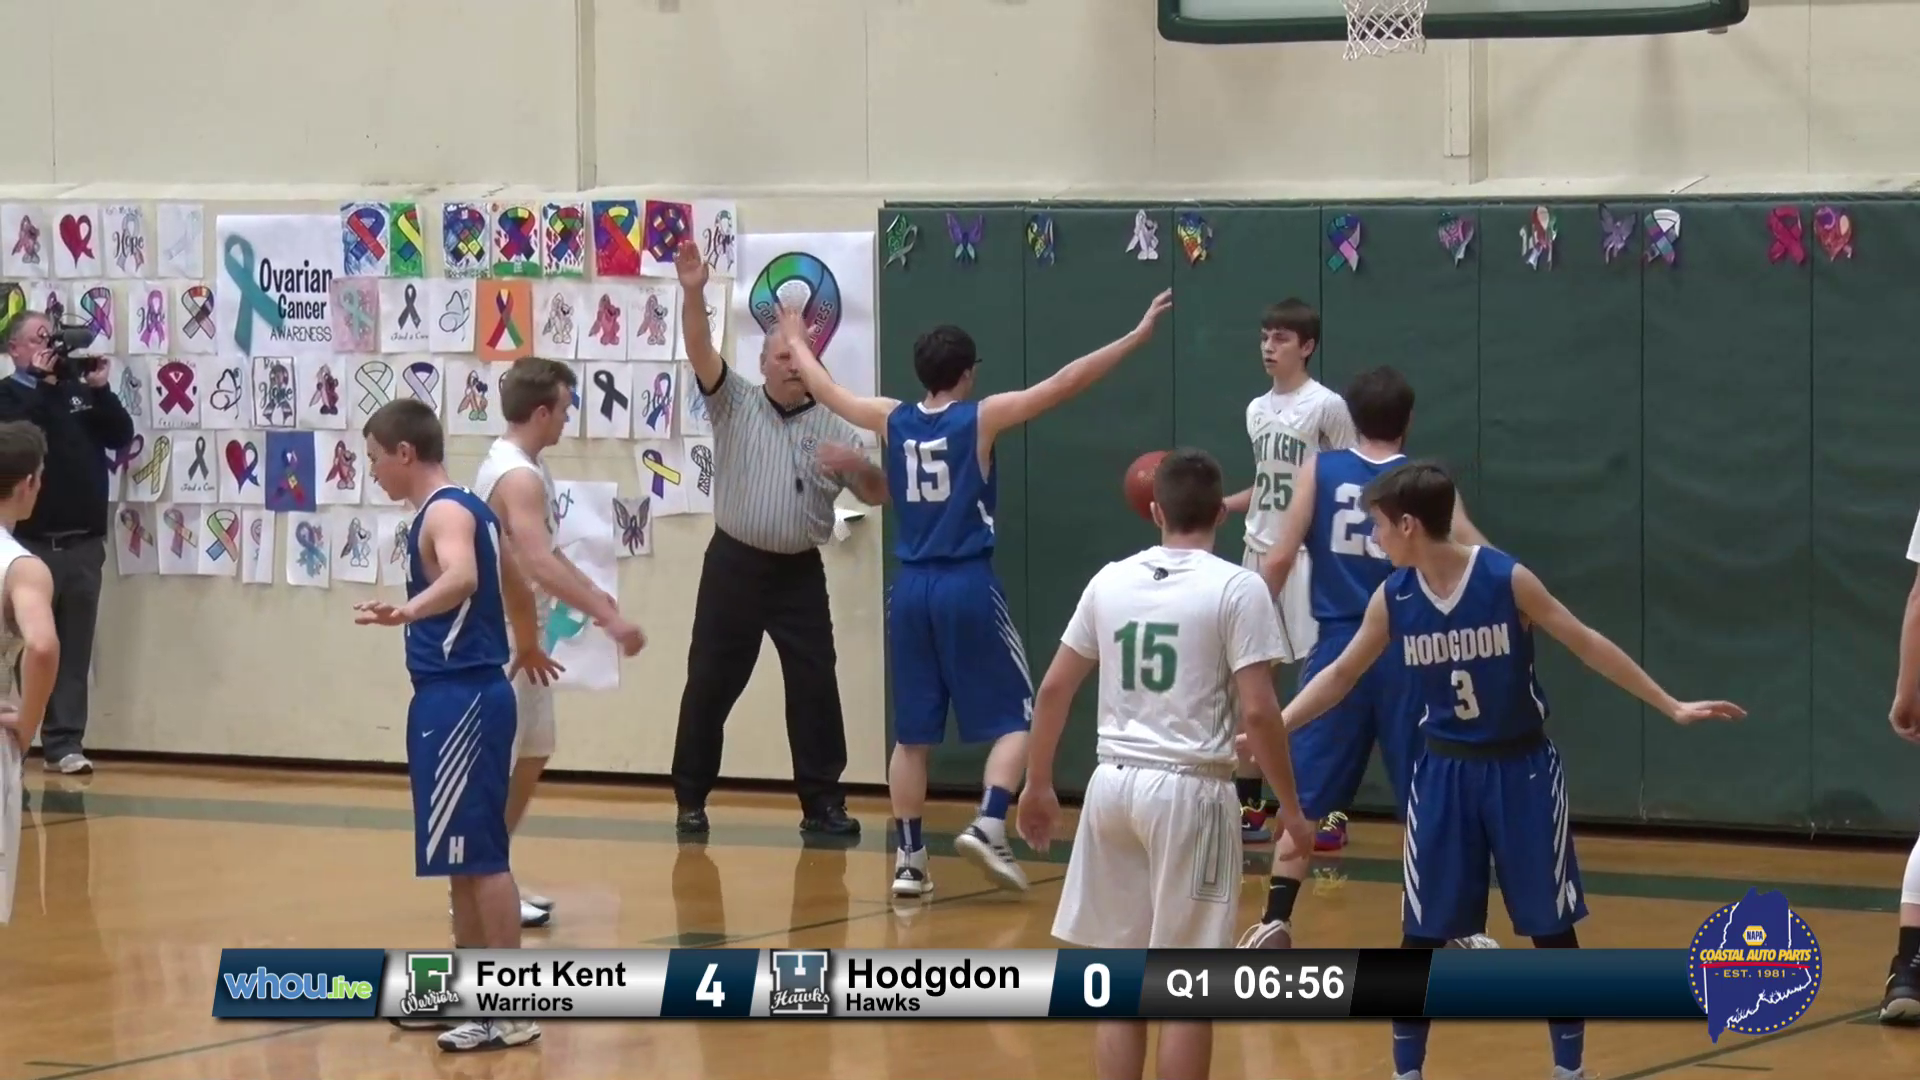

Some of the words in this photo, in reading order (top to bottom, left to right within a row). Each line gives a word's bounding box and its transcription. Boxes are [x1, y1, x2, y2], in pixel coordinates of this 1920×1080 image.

[260, 257, 333, 293] Ovarian
[278, 293, 327, 320] Cancer
[270, 325, 332, 342] AWARENESS
[903, 436, 951, 502] 15
[1256, 472, 1293, 512] 25
[1113, 620, 1179, 693] 15
[1403, 622, 1510, 666] HODGDON
[1451, 670, 1480, 720] 3
[448, 836, 465, 865] H
